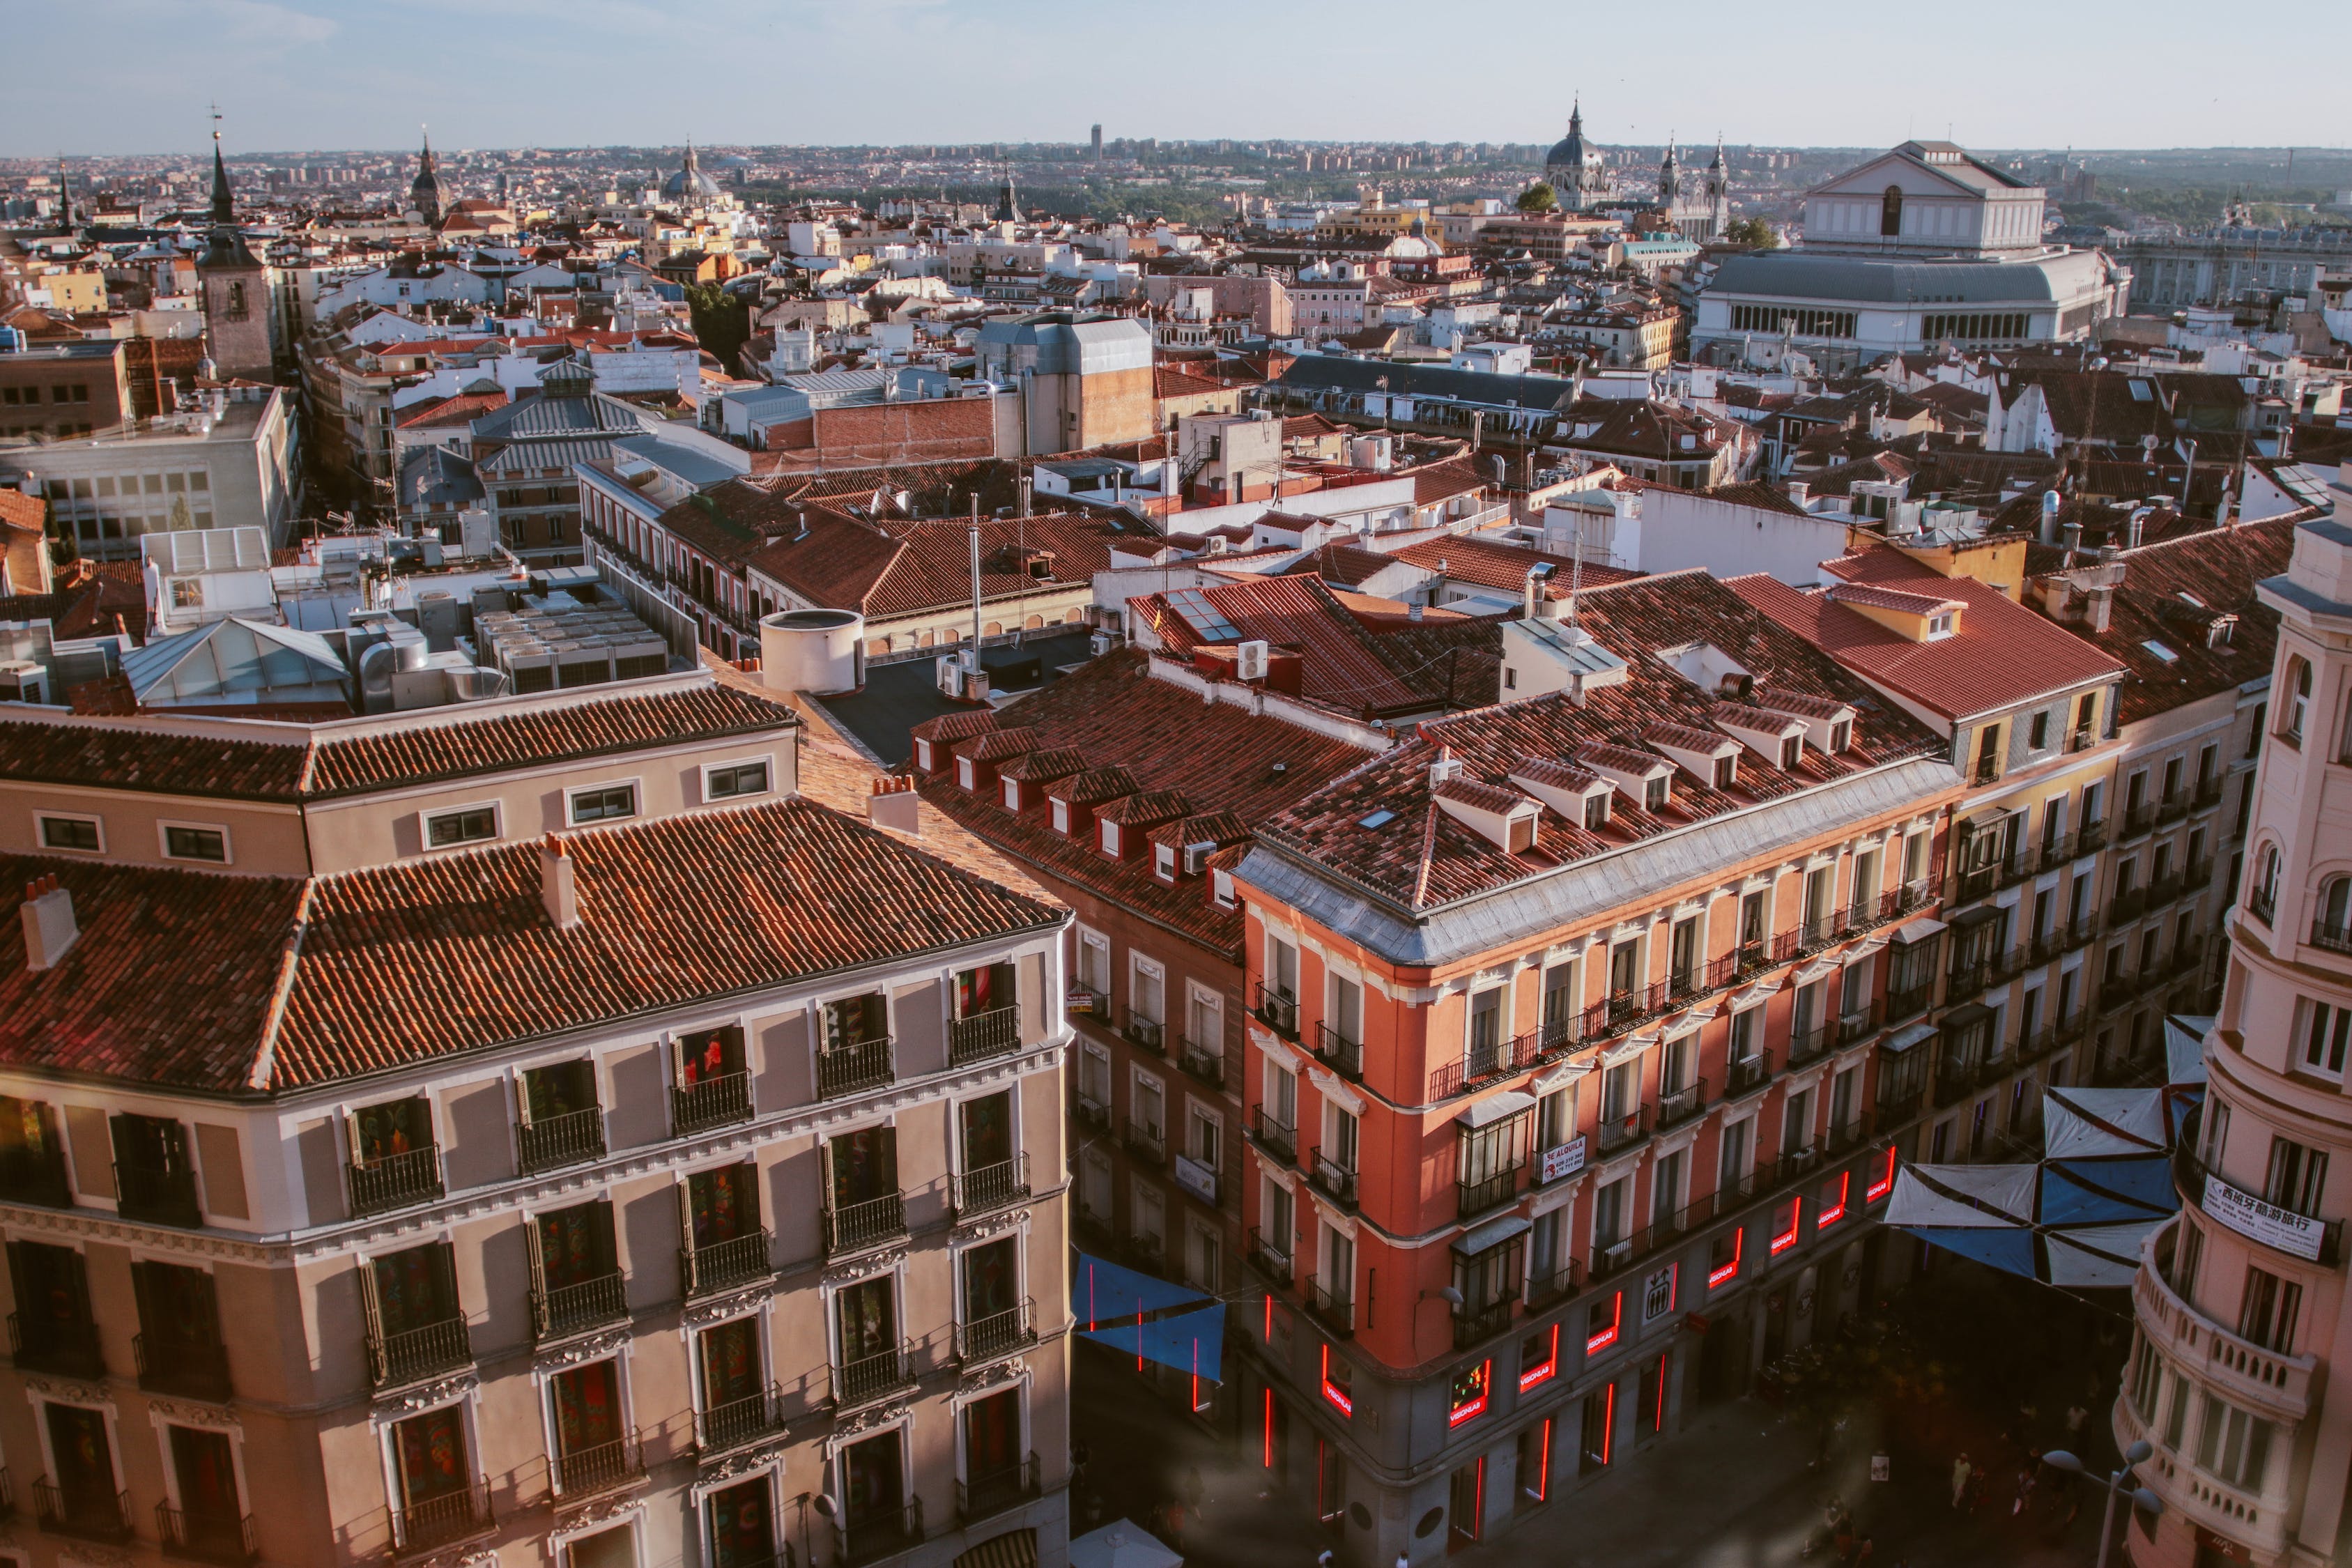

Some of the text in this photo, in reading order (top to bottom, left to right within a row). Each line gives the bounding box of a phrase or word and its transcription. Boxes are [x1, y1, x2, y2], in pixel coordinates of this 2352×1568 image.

[1547, 1140, 1583, 1162] SE ALQUILA
[2222, 1185, 2310, 1231] 西班牙酷游旅行
[1520, 1366, 1549, 1385] VISIONLAB
[1327, 1385, 1352, 1413] VISIONLAB
[1450, 1401, 1481, 1421] VISIONLAB
